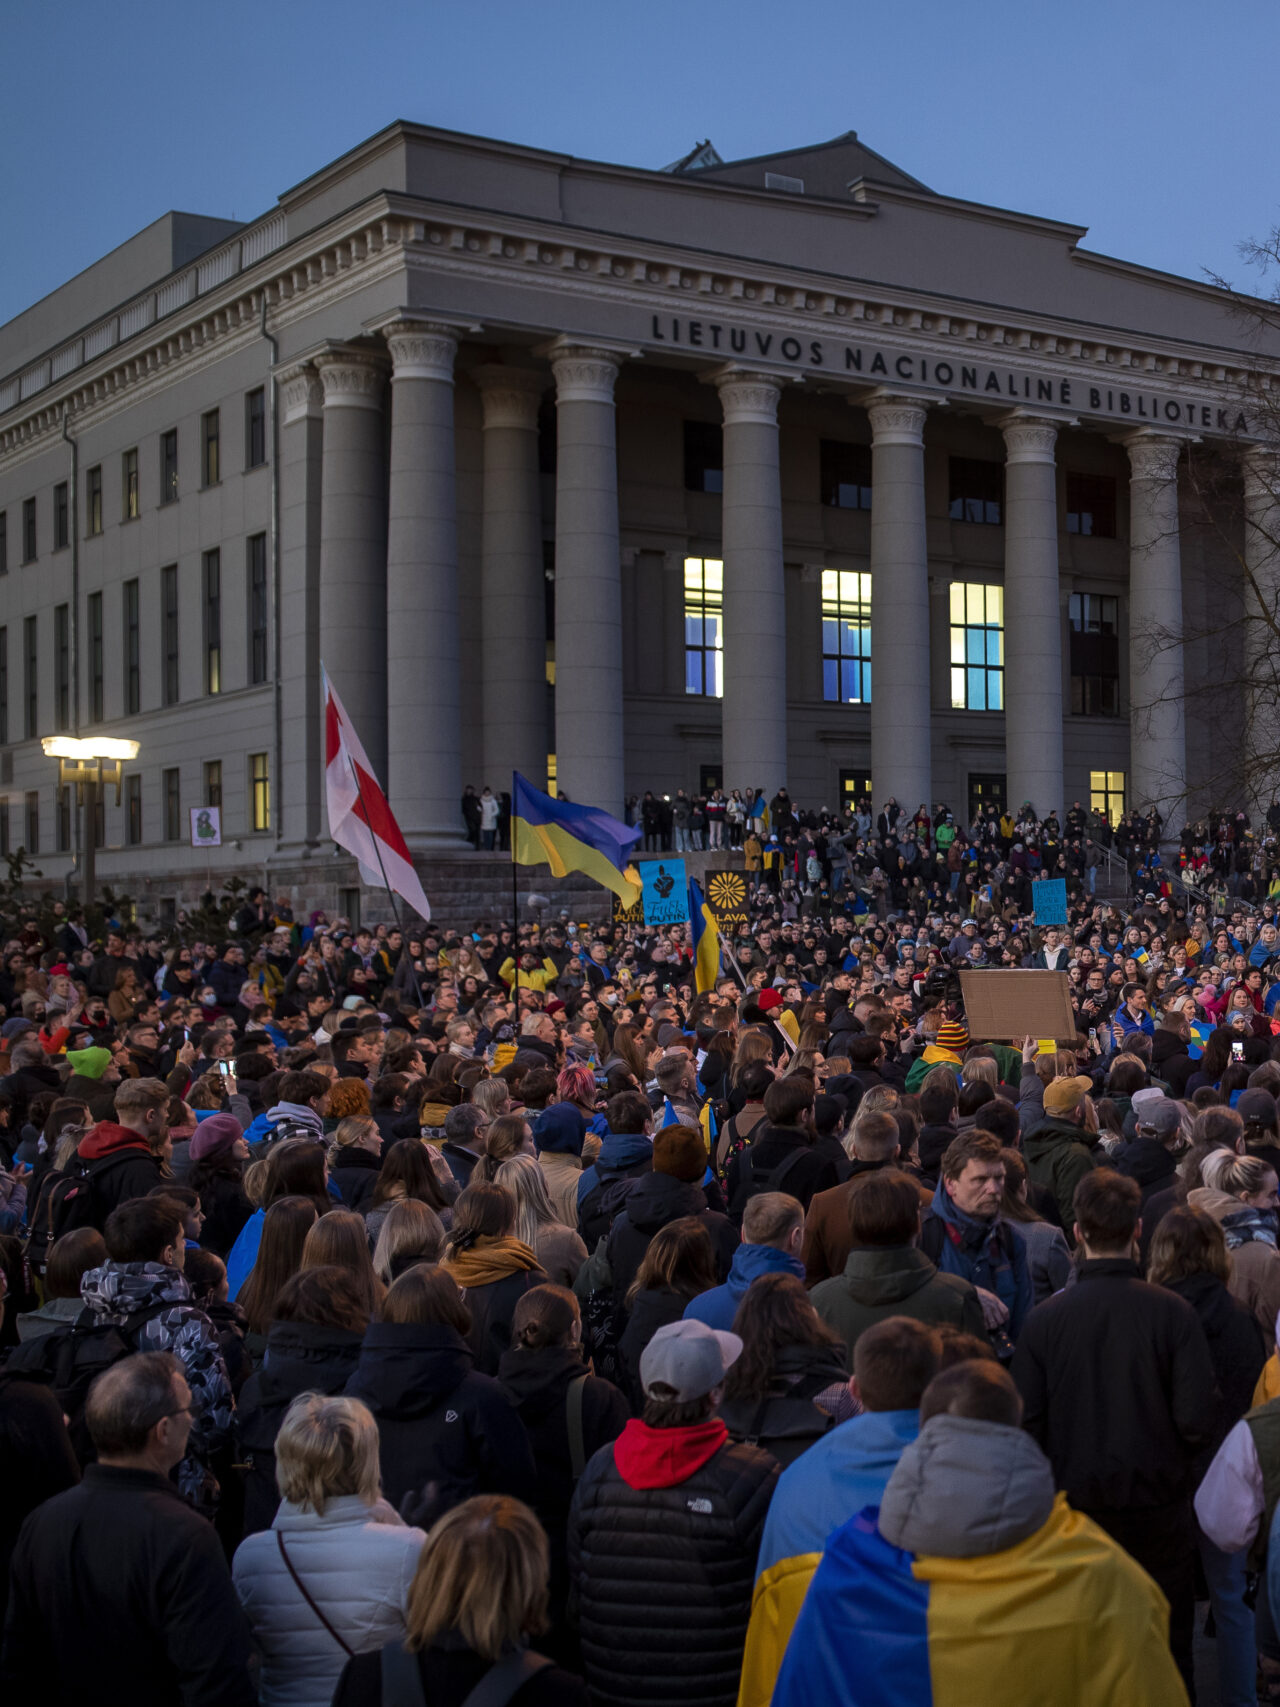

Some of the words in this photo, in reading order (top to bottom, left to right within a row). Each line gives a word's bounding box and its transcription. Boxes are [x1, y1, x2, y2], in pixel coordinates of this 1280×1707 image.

[652, 315, 823, 365] LIETUVOS
[845, 347, 1071, 404] NACIONALINĖ
[1090, 388, 1248, 432] BIBLIOTEKA
[648, 900, 684, 916] Fuck
[649, 913, 685, 923] PUTIN
